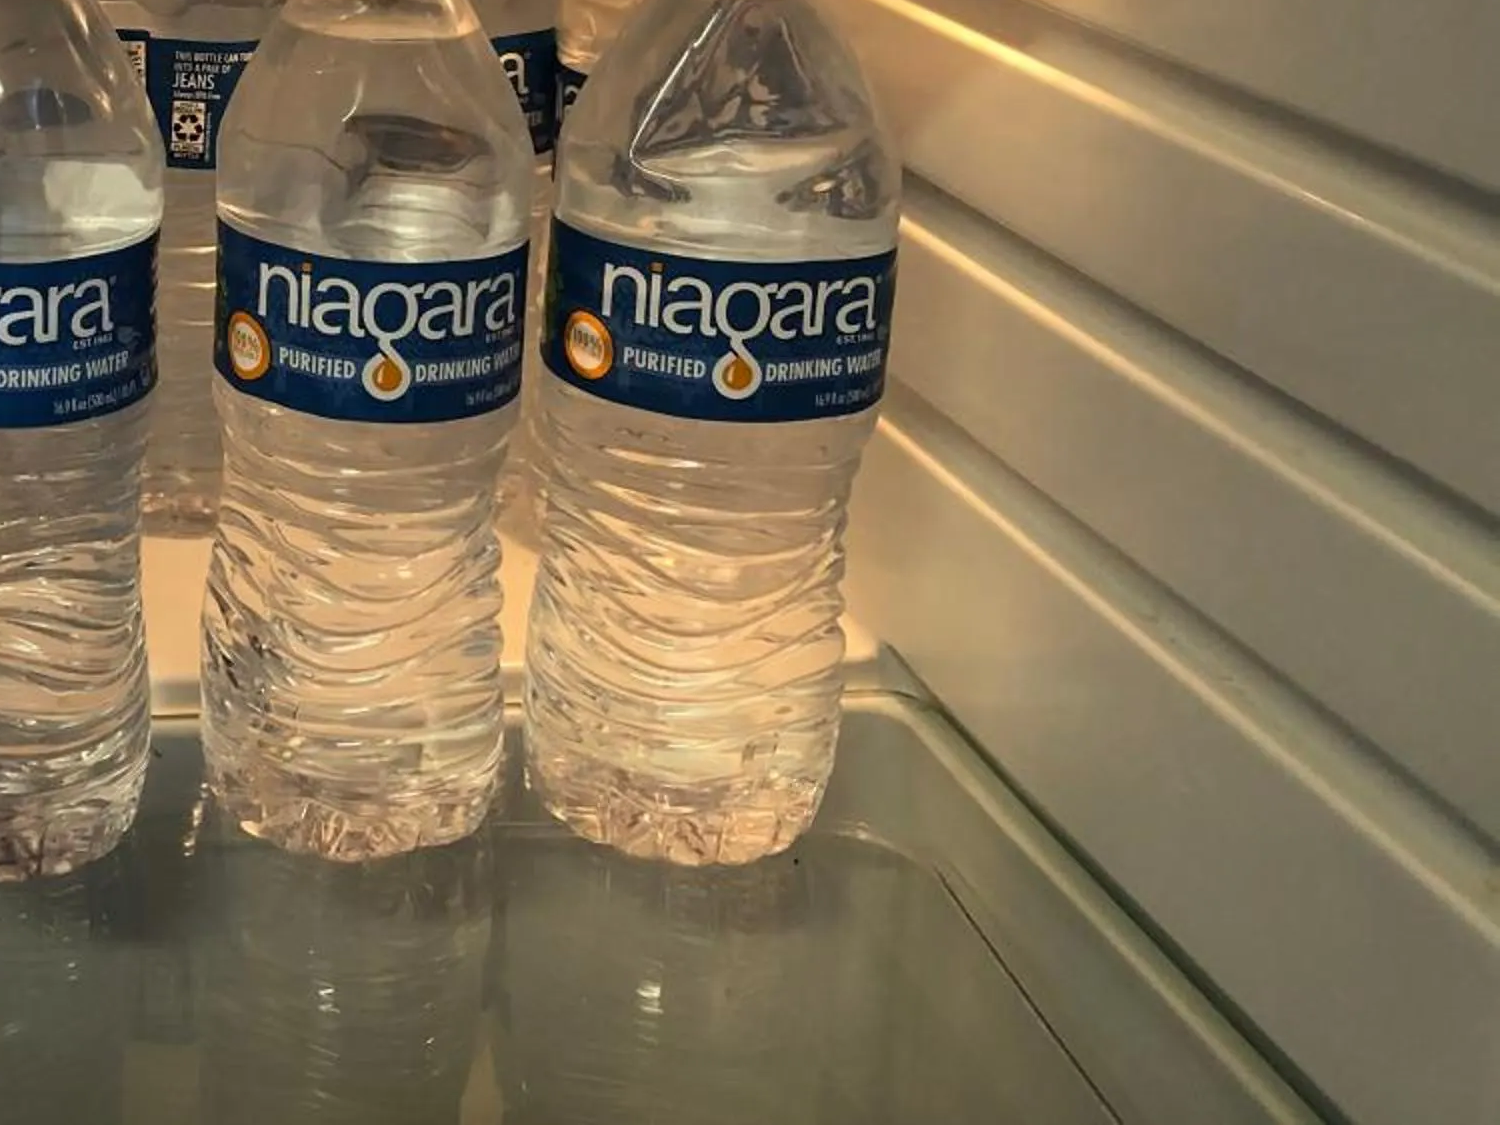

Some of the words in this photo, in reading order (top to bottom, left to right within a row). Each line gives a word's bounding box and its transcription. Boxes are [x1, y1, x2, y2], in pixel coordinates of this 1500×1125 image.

[194, 52, 222, 63] BOTTLE
[224, 53, 239, 63] CAN
[221, 64, 231, 74] OF
[172, 72, 215, 90] JEANS
[257, 260, 518, 355] niagara
[601, 262, 878, 354] niagara
[85, 350, 130, 380] WATER
[279, 346, 356, 380] PURIFIED
[415, 355, 491, 384] DRINKING
[623, 345, 707, 379] PURIFIED
[765, 355, 843, 383] DRINKING
